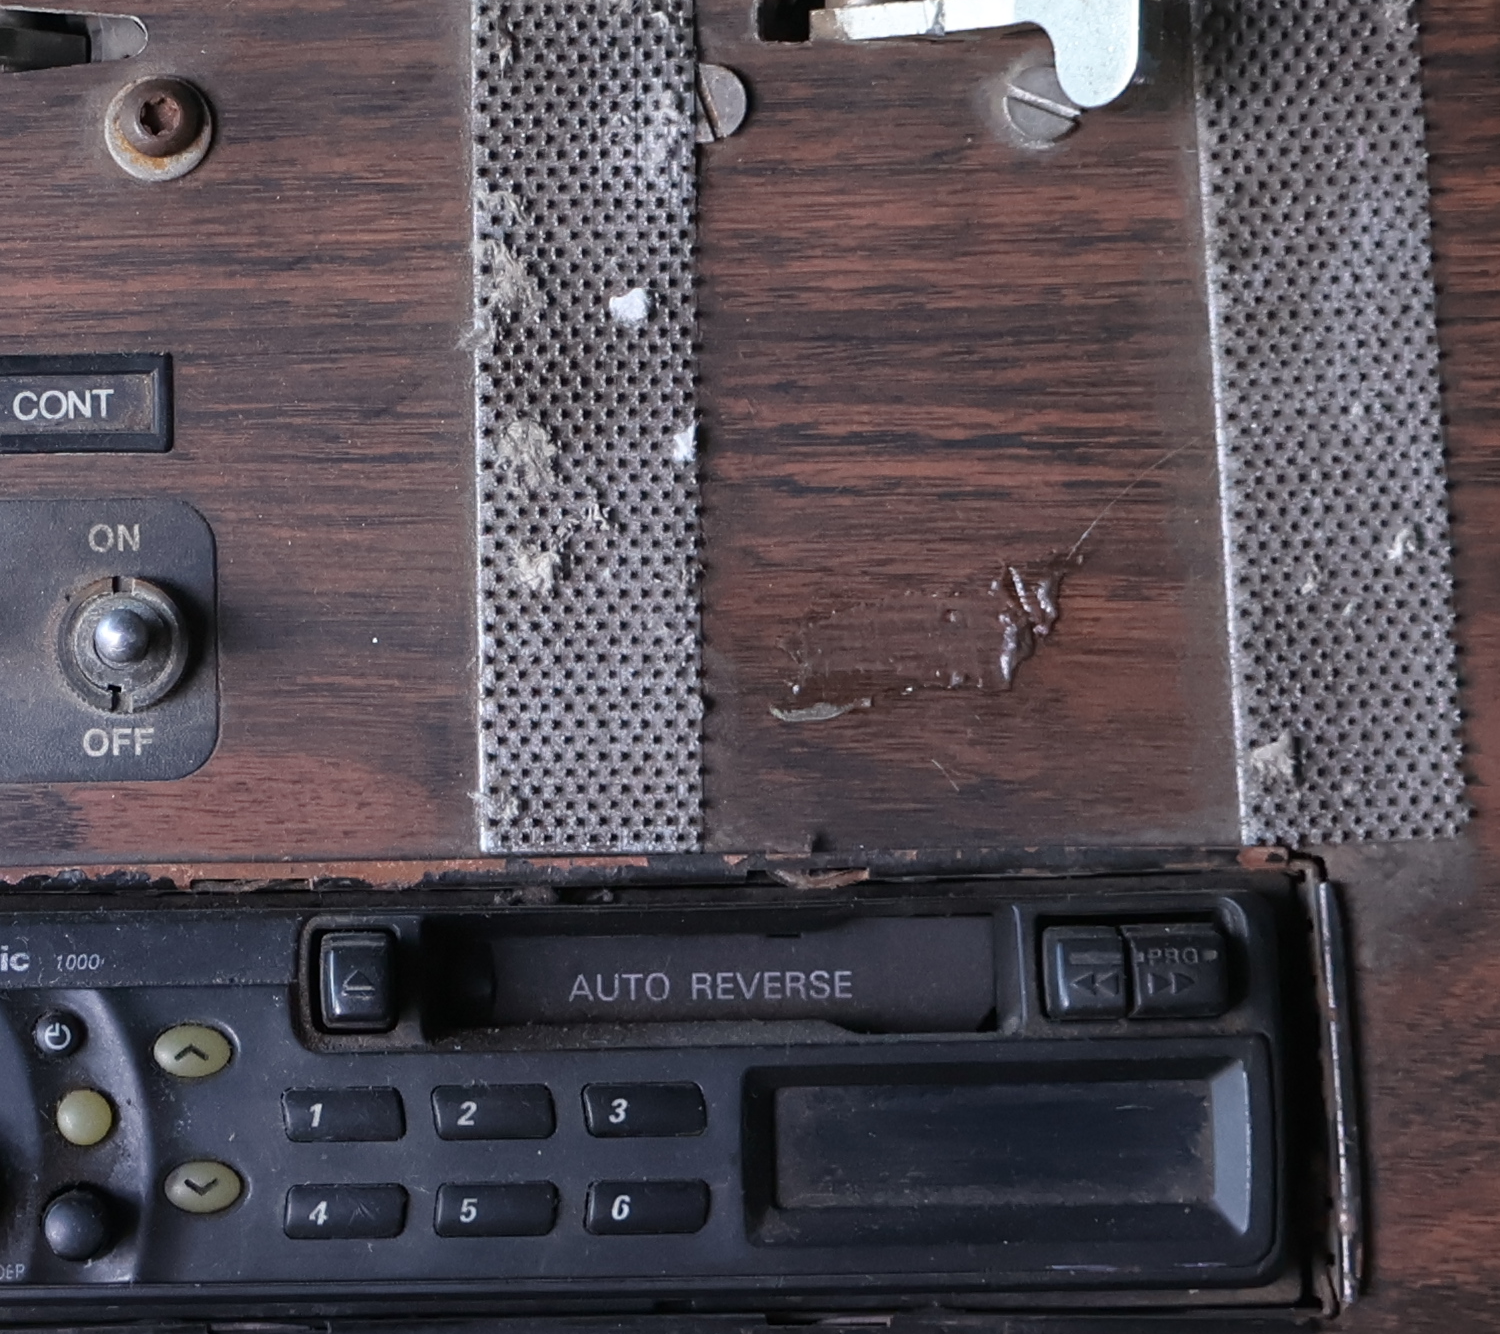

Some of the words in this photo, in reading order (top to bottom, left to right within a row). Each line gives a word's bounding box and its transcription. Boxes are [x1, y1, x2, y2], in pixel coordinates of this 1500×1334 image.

[12, 390, 114, 421] CONT
[89, 524, 141, 552] ON
[83, 728, 155, 757] OFF
[569, 972, 670, 1001] AUTO
[691, 971, 853, 1000] REVERSE
[309, 1102, 323, 1127] 1
[457, 1101, 477, 1126] 2
[608, 1099, 629, 1123] 3
[308, 1202, 328, 1225] 4
[459, 1198, 478, 1222] 5
[611, 1195, 630, 1220] 6
